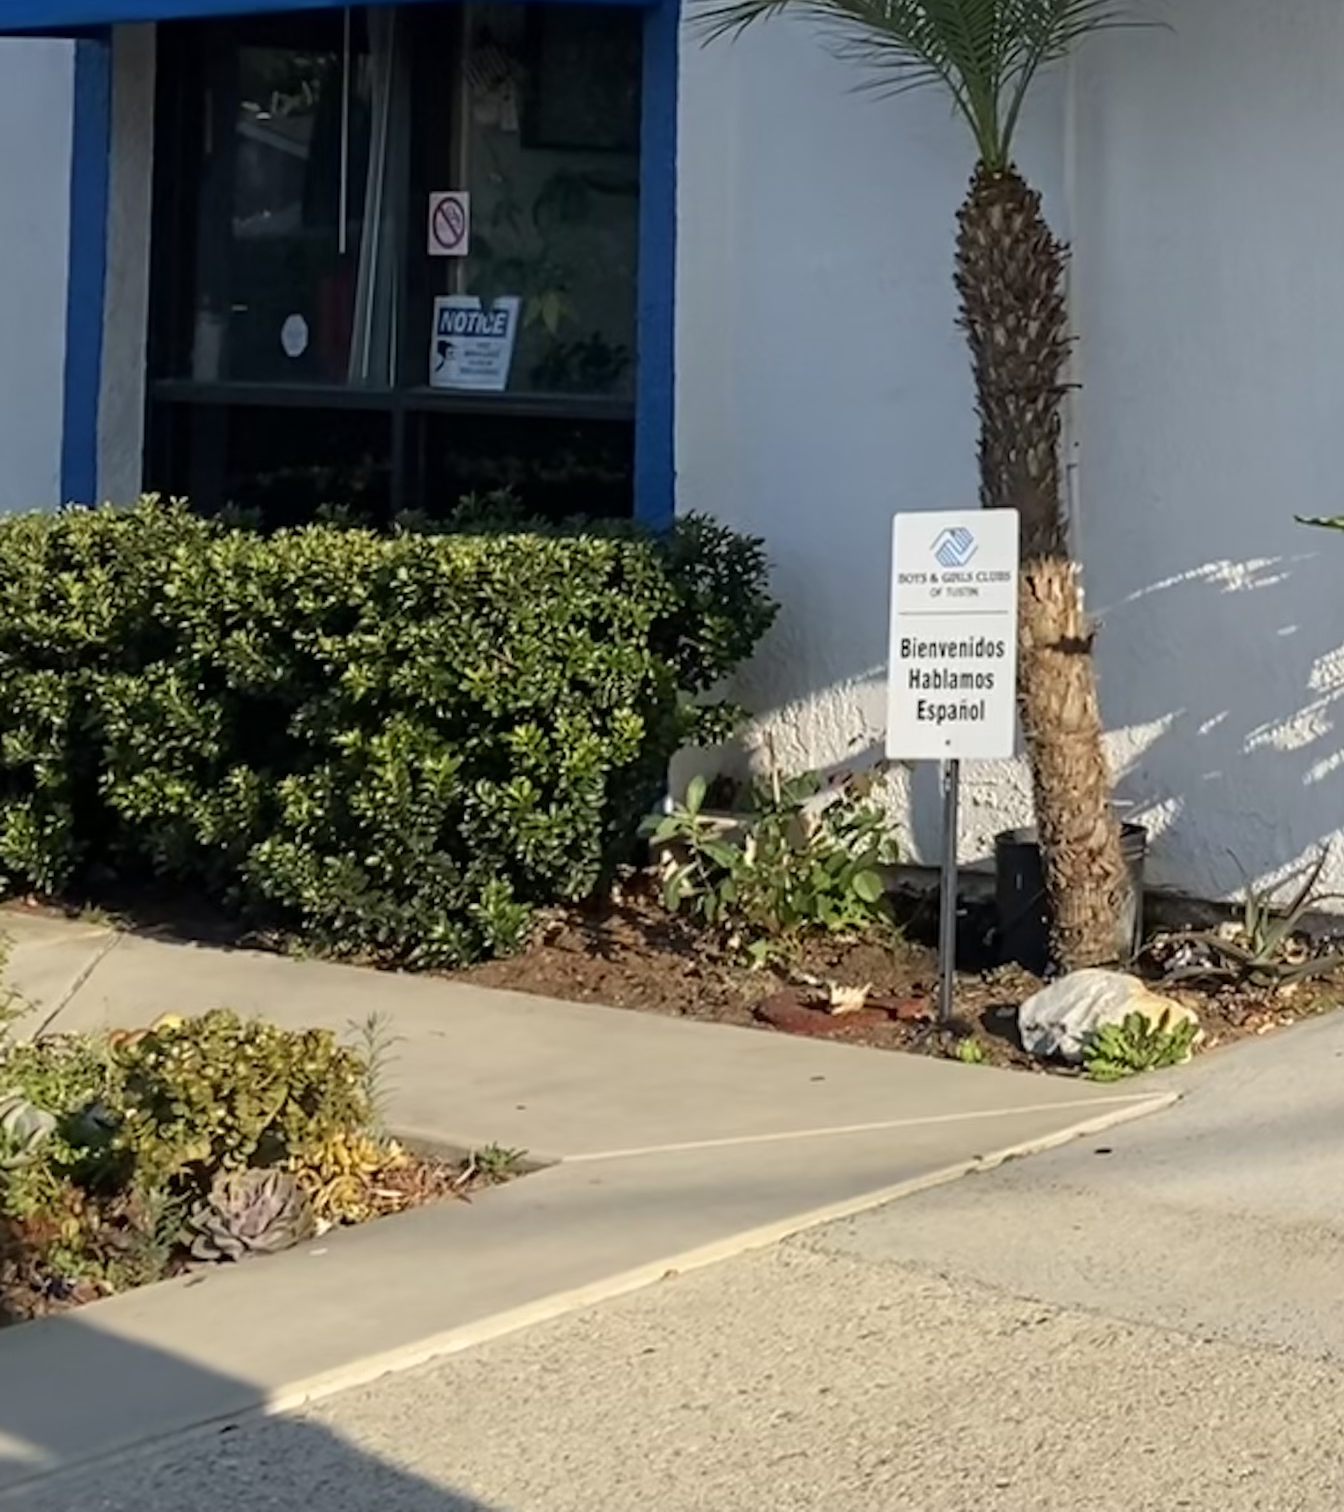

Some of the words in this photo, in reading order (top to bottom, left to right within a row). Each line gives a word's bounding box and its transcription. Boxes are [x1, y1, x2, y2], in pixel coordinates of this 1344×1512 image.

[440, 311, 507, 334] NOTICE
[898, 572, 927, 584] BOYS
[941, 572, 973, 583] GIRLS
[901, 636, 1005, 659] Bienvenidos
[908, 668, 994, 689] Hablamos
[916, 699, 985, 725] Español
